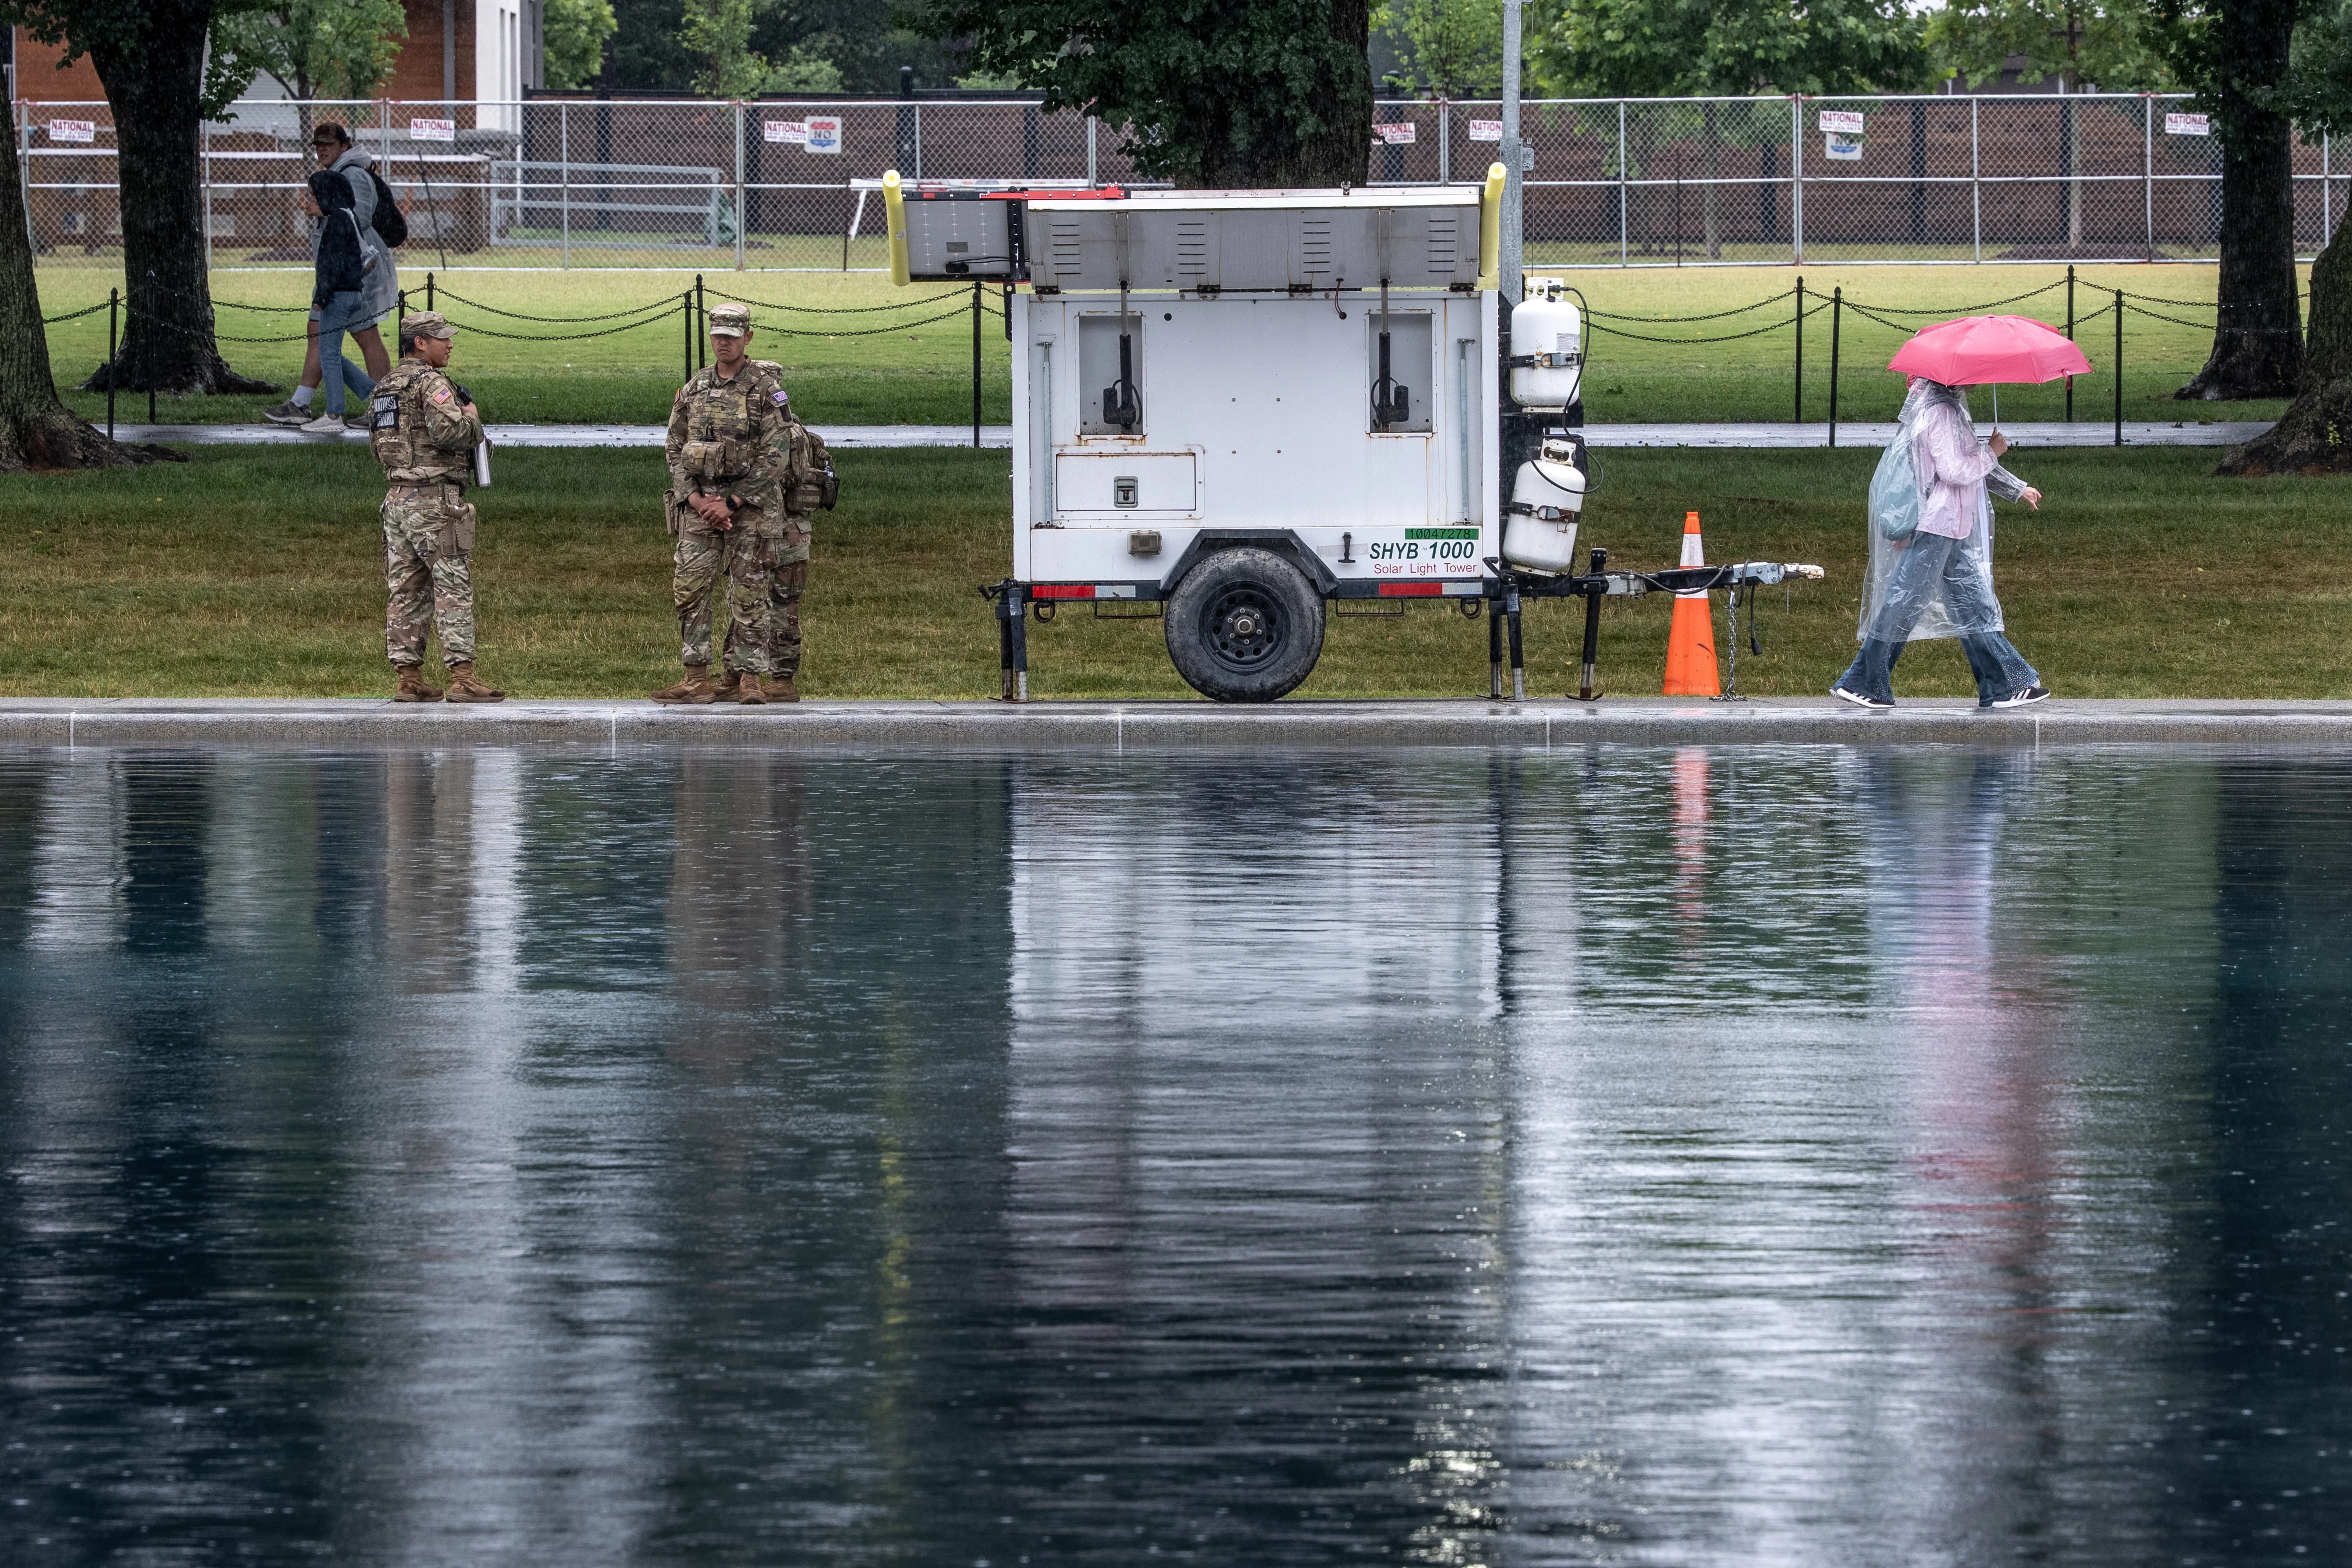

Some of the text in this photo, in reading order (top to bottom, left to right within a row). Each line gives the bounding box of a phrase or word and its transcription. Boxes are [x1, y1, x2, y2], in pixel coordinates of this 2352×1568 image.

[1822, 112, 1861, 123] NATIONAL
[2168, 115, 2208, 125] NATIONAL
[52, 121, 92, 132] NATIONAL
[413, 120, 452, 131] NATIONAL
[766, 122, 806, 133] NATIONAL
[1373, 124, 1413, 134] NATIONAL
[1472, 121, 1502, 131] NATION
[815, 130, 831, 139] NO
[1409, 528, 1471, 539] 10047278
[1370, 543, 1418, 559] SHYB
[1429, 541, 1474, 559] 1000
[1374, 563, 1477, 575] Solar Light Tower
